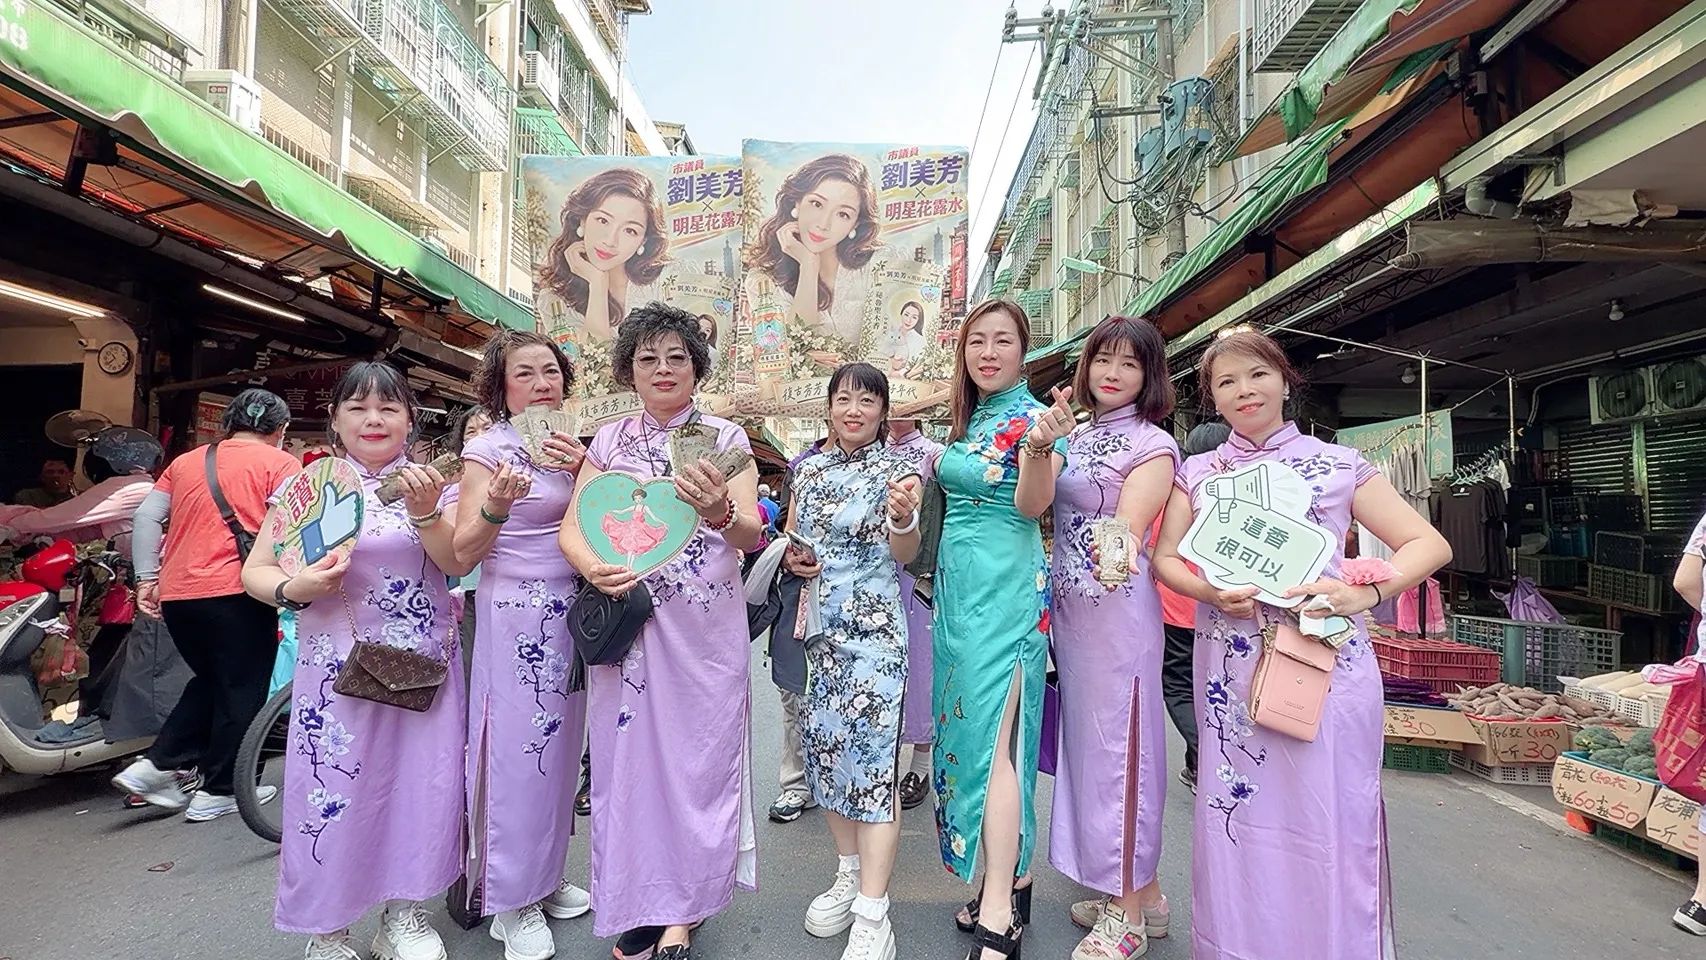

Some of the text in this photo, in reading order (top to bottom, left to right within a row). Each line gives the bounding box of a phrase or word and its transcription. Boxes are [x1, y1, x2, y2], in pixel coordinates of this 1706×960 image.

[673, 159, 704, 174] 市議員
[888, 147, 919, 160] 市議員
[667, 169, 743, 206] 劉美芳
[881, 156, 963, 191] 劉美芳
[885, 197, 963, 221] 明星花露水
[288, 473, 315, 522] 讚
[1240, 515, 1290, 550] 這香
[1215, 535, 1285, 582] 很可以
[1403, 720, 1436, 736] 30
[1524, 741, 1557, 760] 30
